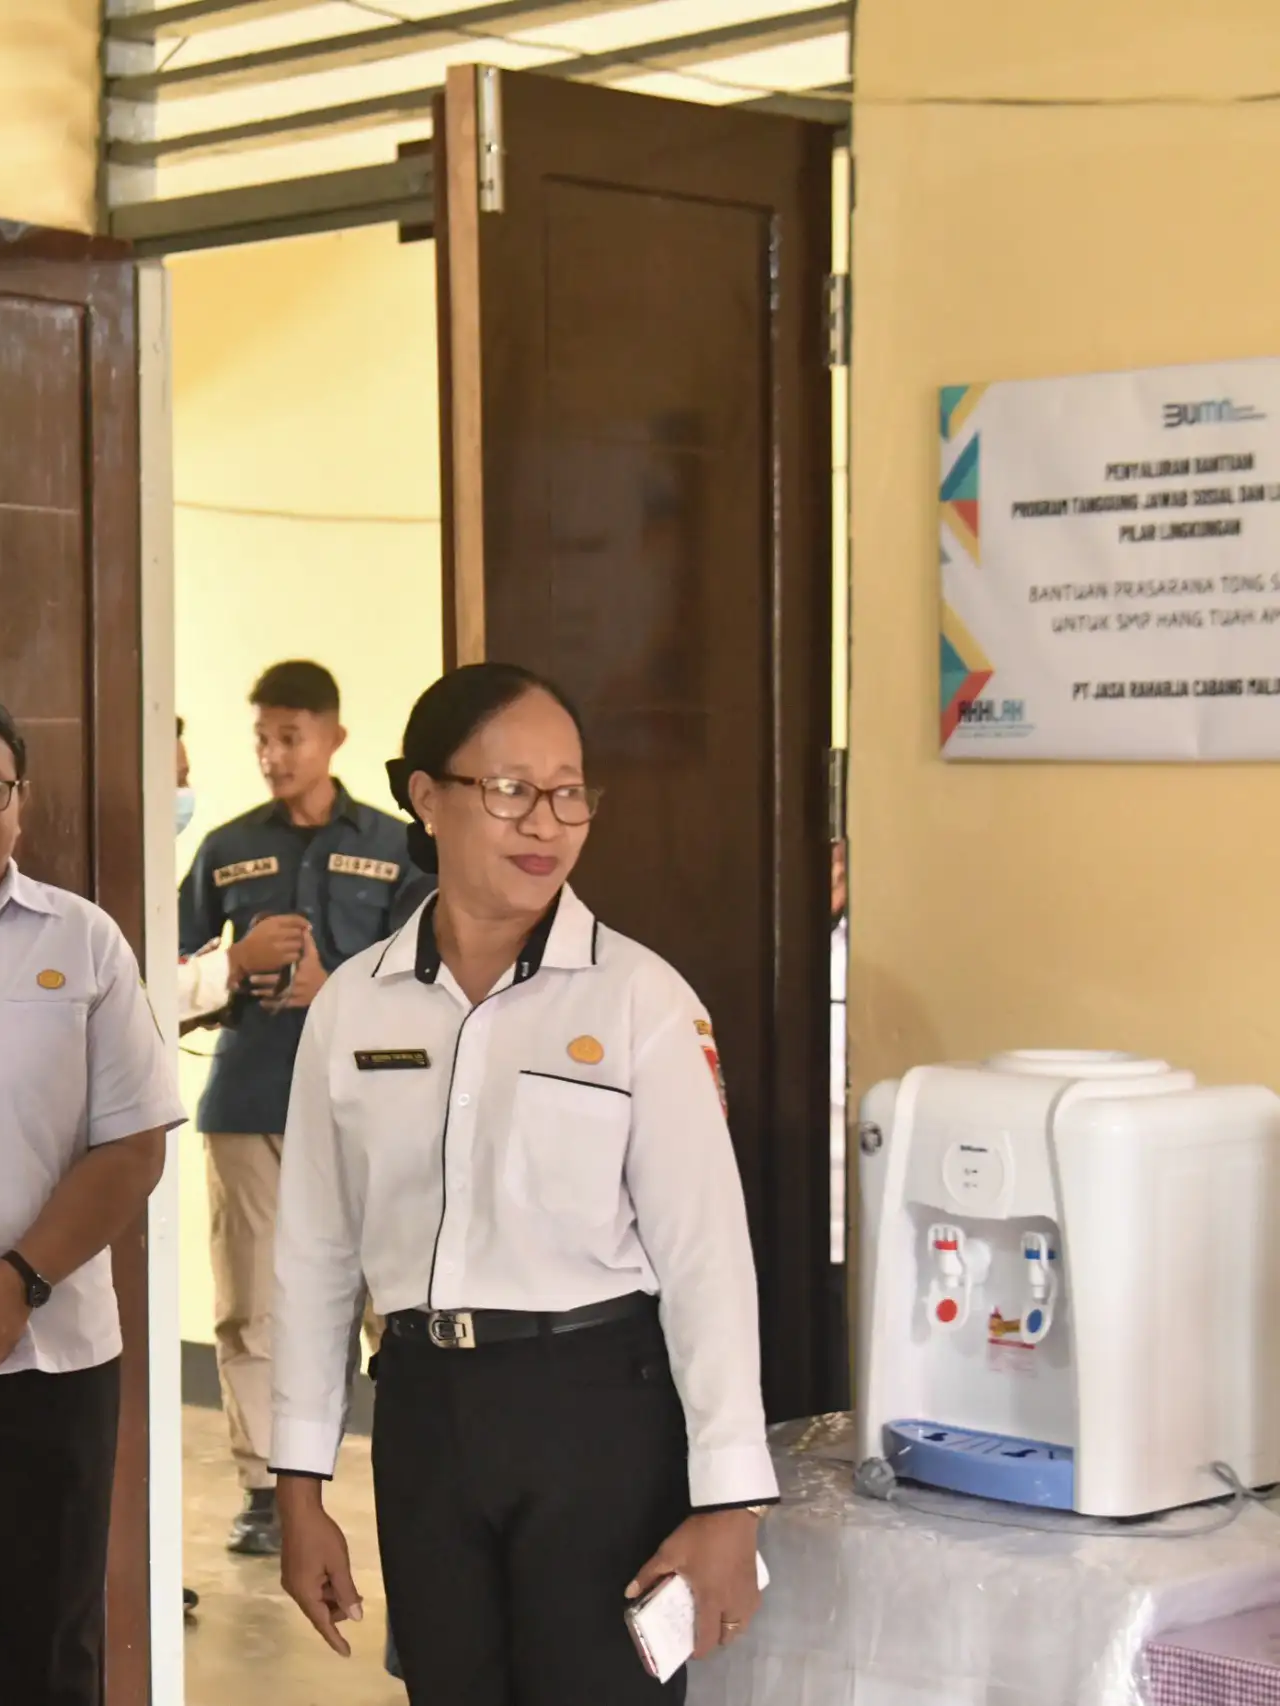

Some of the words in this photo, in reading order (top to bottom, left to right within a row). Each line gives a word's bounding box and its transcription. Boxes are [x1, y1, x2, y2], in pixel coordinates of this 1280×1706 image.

[1105, 457, 1190, 481] PENYALURAN
[1195, 452, 1254, 475] BANTUAN
[1011, 500, 1067, 519] PROGRAM
[1072, 493, 1138, 514] TANGGUNG
[1144, 489, 1188, 511] JAWAB
[1118, 523, 1156, 543] PILAR
[1160, 518, 1241, 541] LINGKUNGAN
[1029, 583, 1108, 603] BANTUAN
[1113, 577, 1214, 600] PRASARANA
[1220, 573, 1265, 594] TONG
[1051, 613, 1108, 633] UNTUK
[1116, 610, 1152, 632] SMP
[1156, 609, 1203, 628] HANG
[1208, 607, 1254, 627] TUAH
[1073, 681, 1090, 700] PT
[1093, 680, 1126, 699] JASA
[1129, 679, 1189, 698] RAHARJA
[1193, 677, 1243, 697] CABANG
